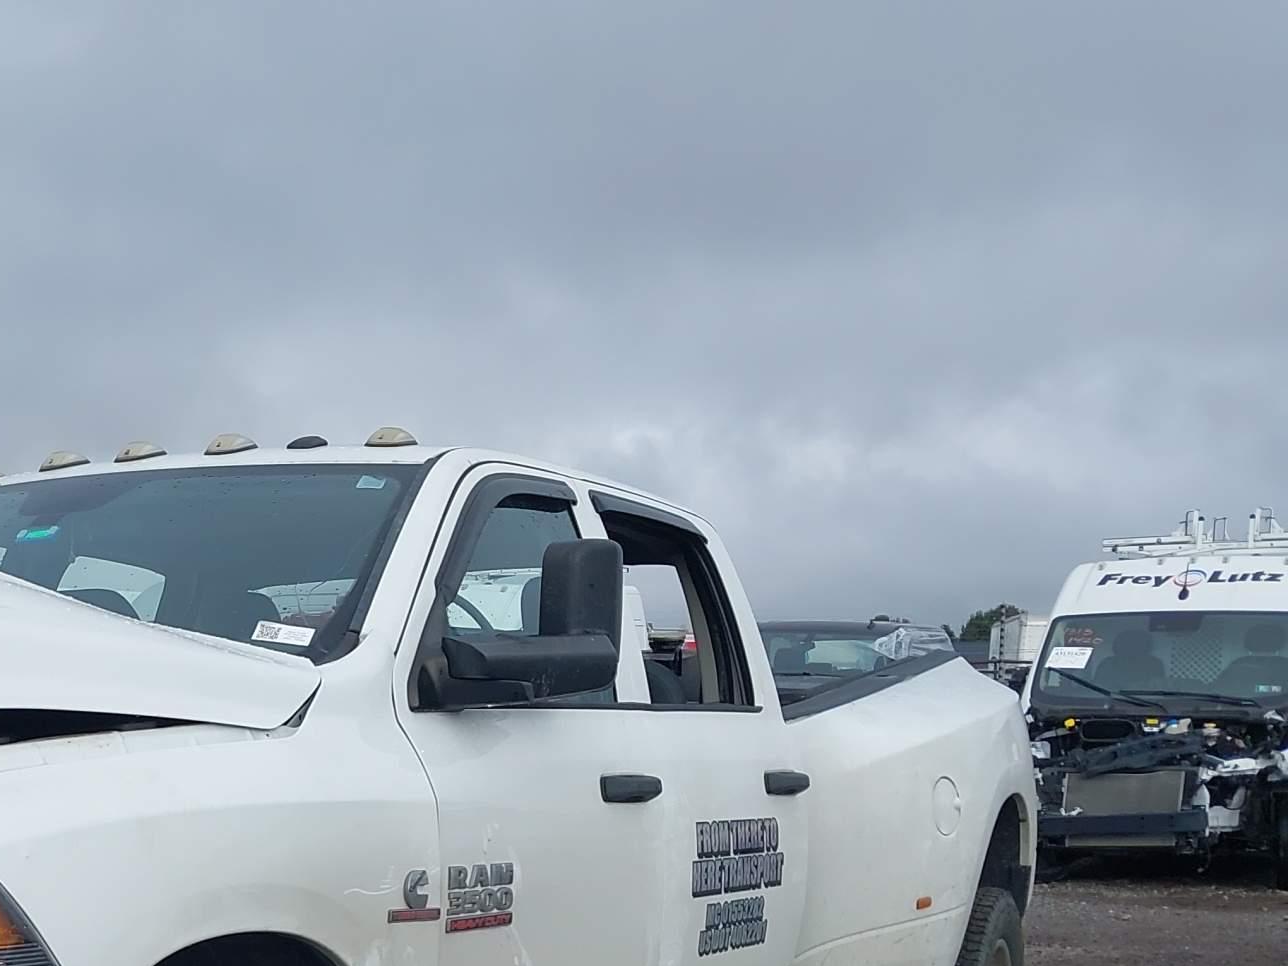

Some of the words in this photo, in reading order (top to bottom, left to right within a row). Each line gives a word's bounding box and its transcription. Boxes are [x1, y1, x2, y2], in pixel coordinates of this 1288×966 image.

[1096, 573, 1173, 588] Frey
[1207, 570, 1285, 583] Lutz
[696, 820, 730, 859] FROM
[730, 818, 765, 855] THERE
[763, 817, 779, 852] TO
[447, 862, 513, 890] RAM
[692, 859, 722, 898] HERE
[722, 852, 784, 893] TRANSPORT
[447, 887, 513, 916] 3500
